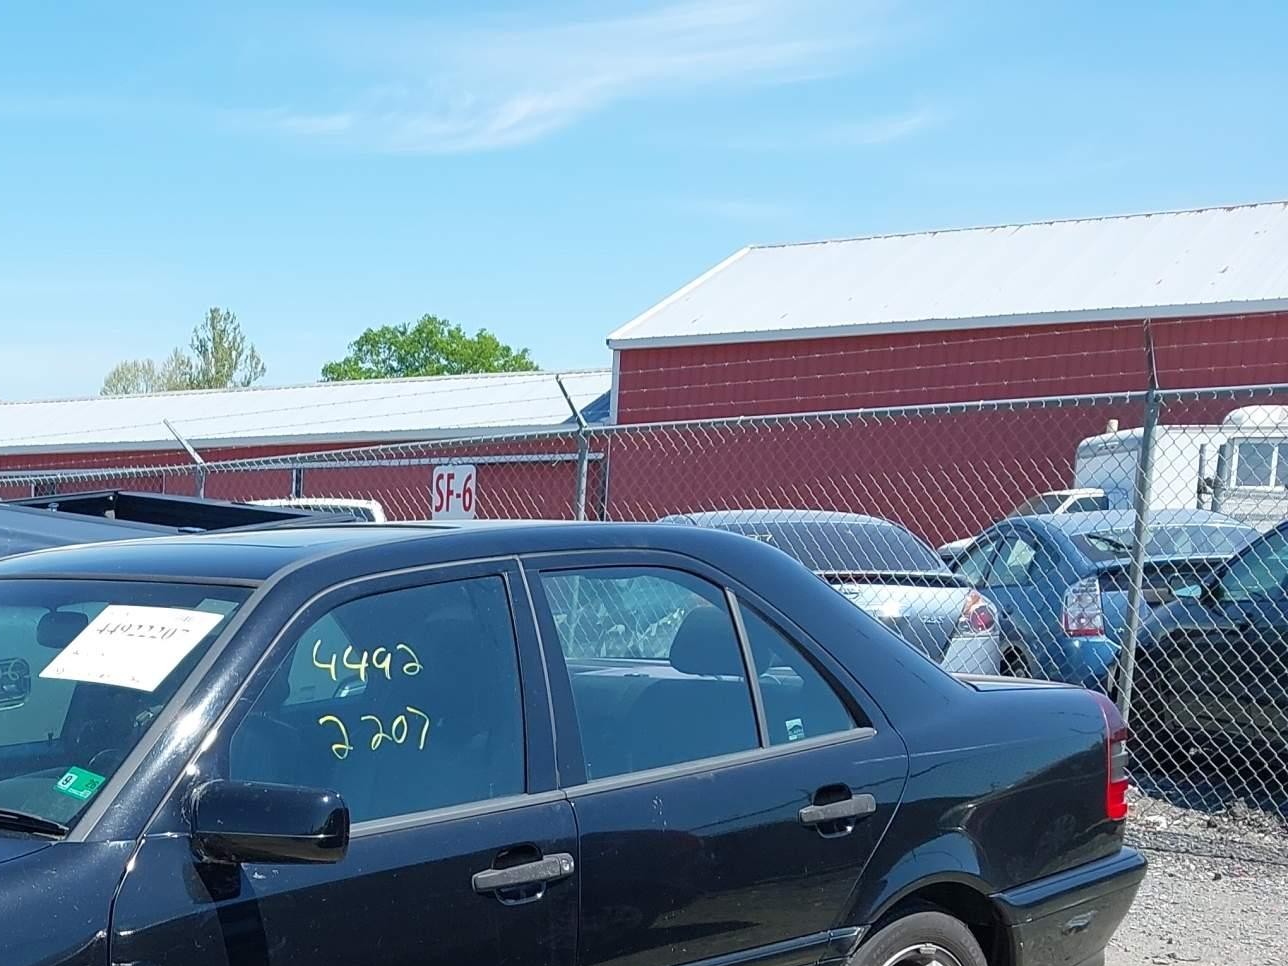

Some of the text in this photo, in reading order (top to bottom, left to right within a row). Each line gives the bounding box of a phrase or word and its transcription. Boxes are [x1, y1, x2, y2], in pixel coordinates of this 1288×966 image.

[434, 472, 473, 513] SF-6
[312, 639, 424, 682] 4492
[318, 706, 430, 760] 2207
